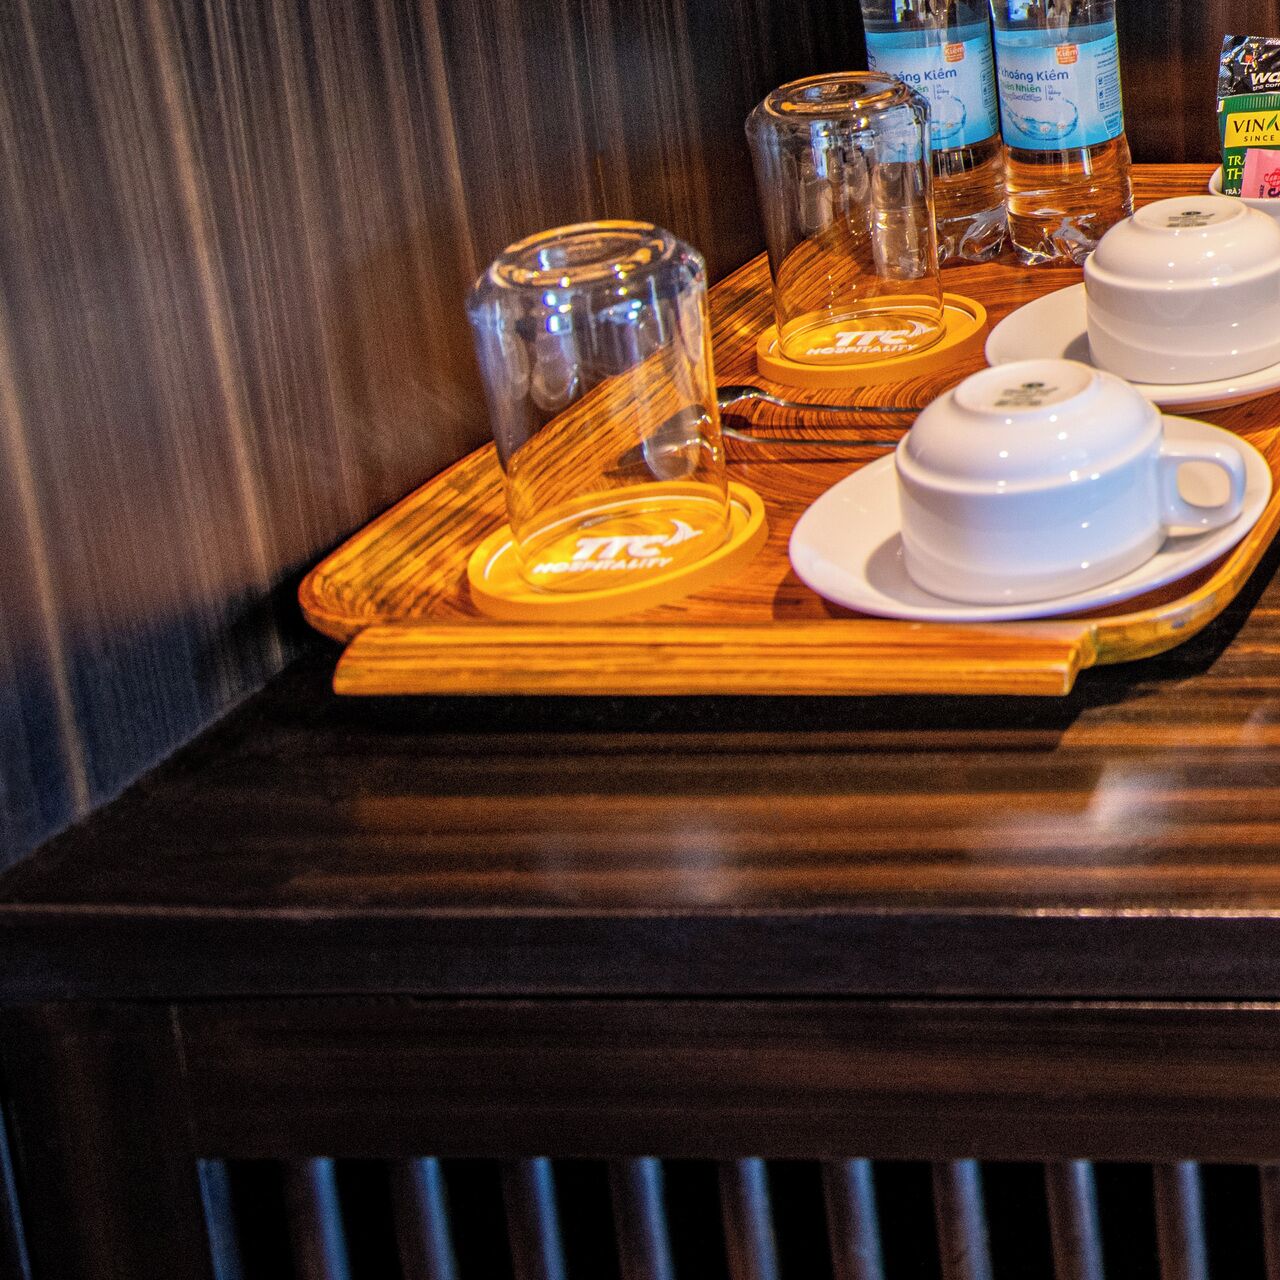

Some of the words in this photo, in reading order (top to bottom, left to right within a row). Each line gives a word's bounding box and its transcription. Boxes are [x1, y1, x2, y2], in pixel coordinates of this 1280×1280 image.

[836, 330, 909, 347] TTC
[806, 344, 919, 356] HOSPITALITY
[572, 535, 669, 562] TTC
[532, 556, 673, 575] HOSPITALITY
